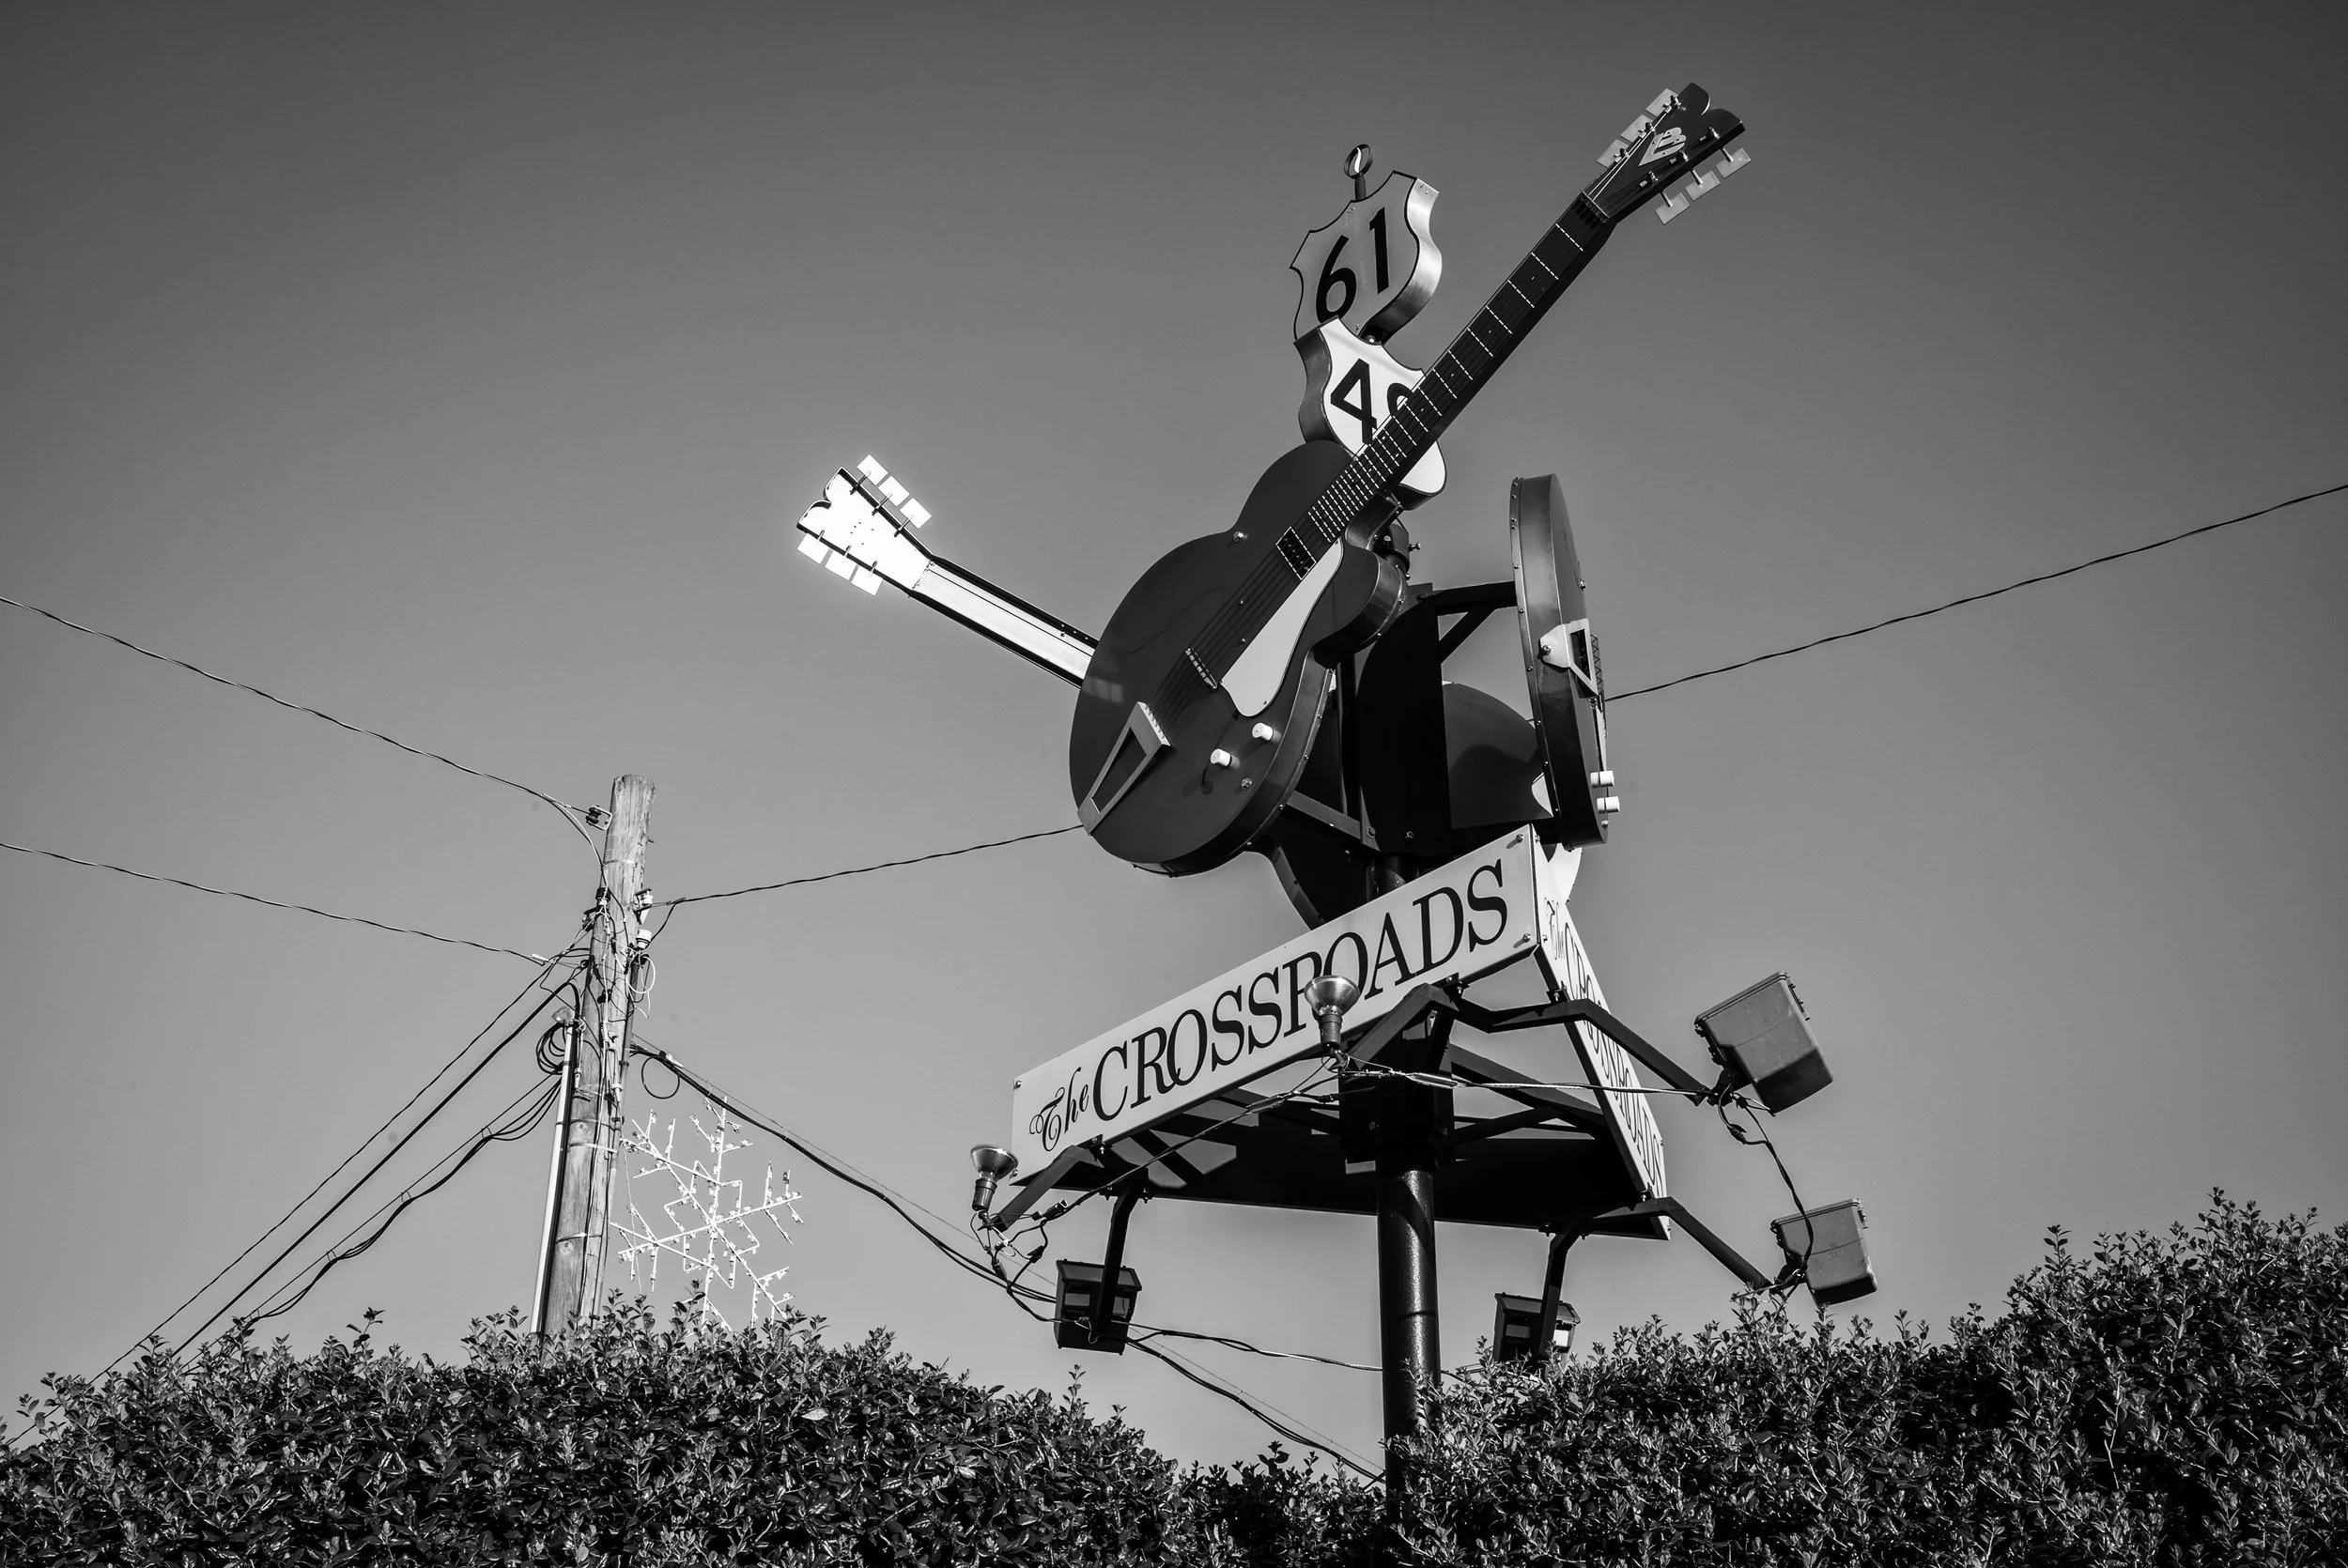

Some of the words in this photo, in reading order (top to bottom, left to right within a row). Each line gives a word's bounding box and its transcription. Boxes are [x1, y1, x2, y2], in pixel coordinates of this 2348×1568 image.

[1316, 207, 1389, 323] 61
[1028, 1067, 1089, 1152] The
[1093, 858, 1507, 1121] CROSSROADS
